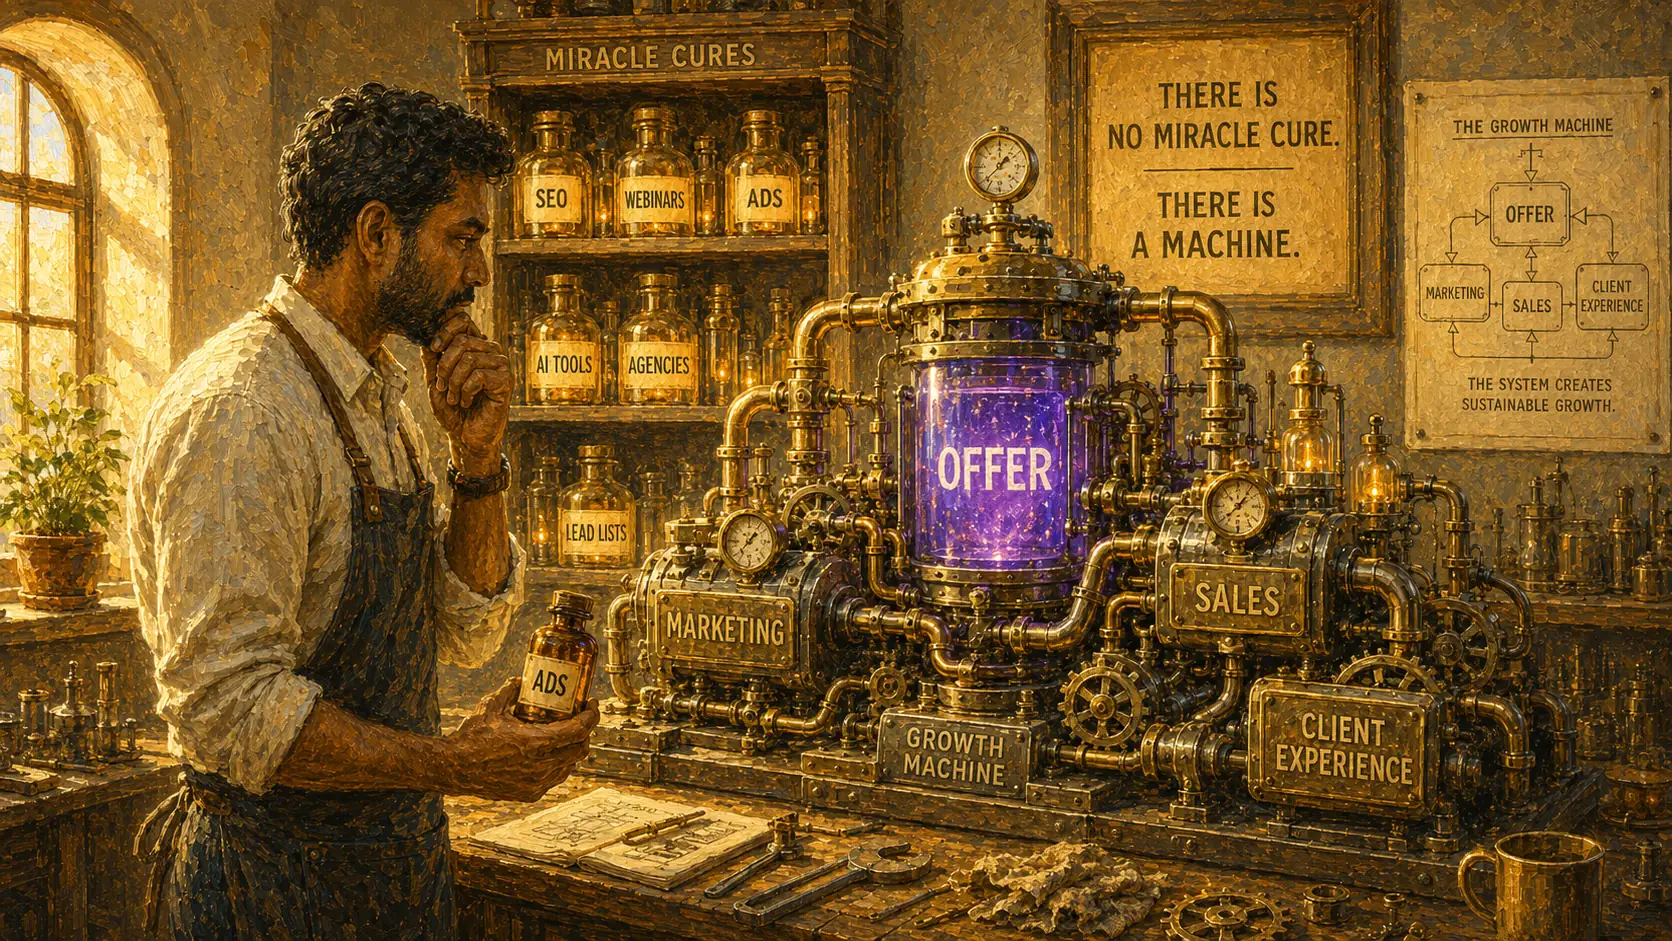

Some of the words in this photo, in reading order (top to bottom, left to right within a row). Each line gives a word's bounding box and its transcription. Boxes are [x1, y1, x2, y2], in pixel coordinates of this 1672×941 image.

[546, 45, 659, 70] MIRACLE
[671, 43, 756, 68] CURES
[1158, 81, 1242, 109] THERE
[1255, 81, 1278, 107] IS
[1108, 123, 1143, 150] NO
[1154, 121, 1260, 149] MIRACLE
[1270, 121, 1340, 148] CURE.
[1453, 120, 1484, 134] THE
[1490, 119, 1549, 133] GROWTH
[1554, 118, 1614, 133] MACHINE
[535, 188, 568, 209] SEO
[624, 189, 685, 210] WEBINARS
[747, 188, 783, 209] ADS
[1157, 191, 1241, 219] THERE
[1253, 191, 1276, 217] IS
[1505, 205, 1555, 224] OFFER
[1131, 231, 1150, 259] A
[1162, 229, 1300, 259] MACHINE.
[1426, 286, 1486, 300] MARKETING
[1592, 280, 1632, 293] CLIENT
[1512, 299, 1552, 313] SALES
[1580, 299, 1644, 313] EXPERIENCE
[536, 356, 549, 374] AI
[552, 355, 592, 374] TOOLS
[628, 356, 690, 375] AGENCIES
[1468, 377, 1494, 391] THE
[1499, 377, 1549, 392] SYSTEM
[1555, 377, 1612, 392] CREATES
[1462, 398, 1549, 413] SUSTAINABLE
[1555, 398, 1616, 413] GROWTH.
[938, 447, 1052, 491] OFFER
[566, 523, 595, 542] LEAD
[598, 523, 627, 542] LISTS
[1195, 582, 1280, 617] SALES
[666, 611, 785, 646] MARKETING
[532, 669, 568, 696] ADS
[1301, 712, 1386, 746] CLIENT
[906, 726, 1004, 759] GROWTH
[903, 753, 1006, 787] MACHINE
[1276, 744, 1414, 786] EXPERIENCE
